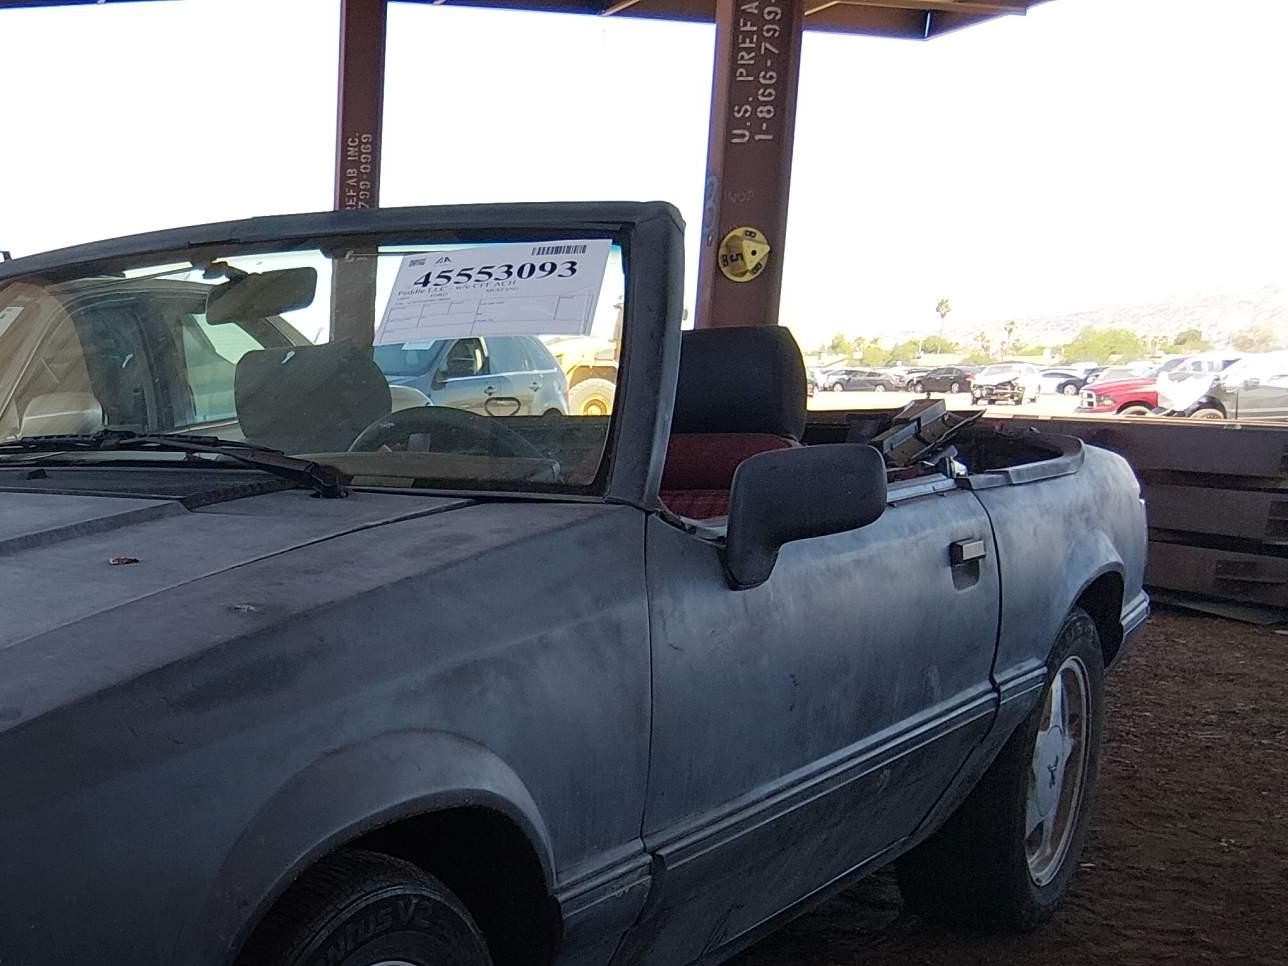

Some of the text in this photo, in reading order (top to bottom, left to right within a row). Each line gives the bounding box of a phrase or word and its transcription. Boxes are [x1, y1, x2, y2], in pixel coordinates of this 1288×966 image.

[730, 96, 753, 143] U.S.
[346, 132, 359, 160] INC.
[413, 260, 578, 288] 45553093
